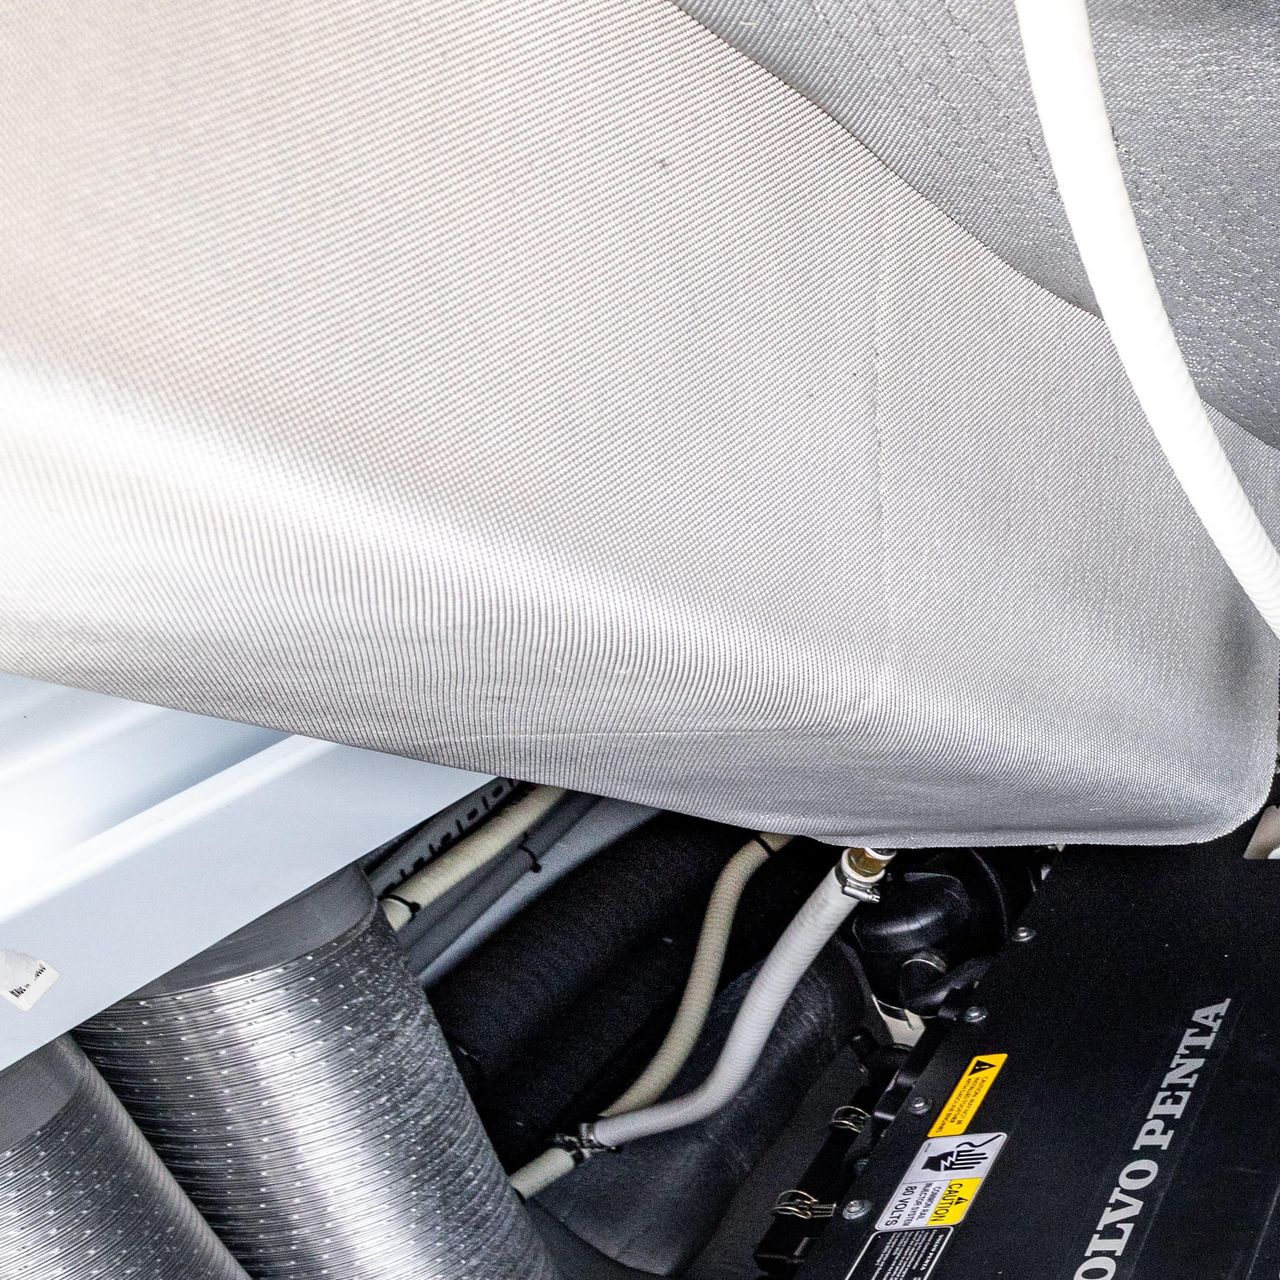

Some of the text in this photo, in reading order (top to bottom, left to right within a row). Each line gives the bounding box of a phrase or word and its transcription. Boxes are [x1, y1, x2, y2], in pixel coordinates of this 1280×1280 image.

[1133, 998, 1231, 1150] PENTA
[901, 1185, 918, 1195] 80
[901, 1182, 932, 1226] INJECTOR SYSTEM
[922, 1186, 941, 1208] COMMON
[929, 1183, 964, 1221] CAUTION
[884, 1198, 911, 1225] VOLTS
